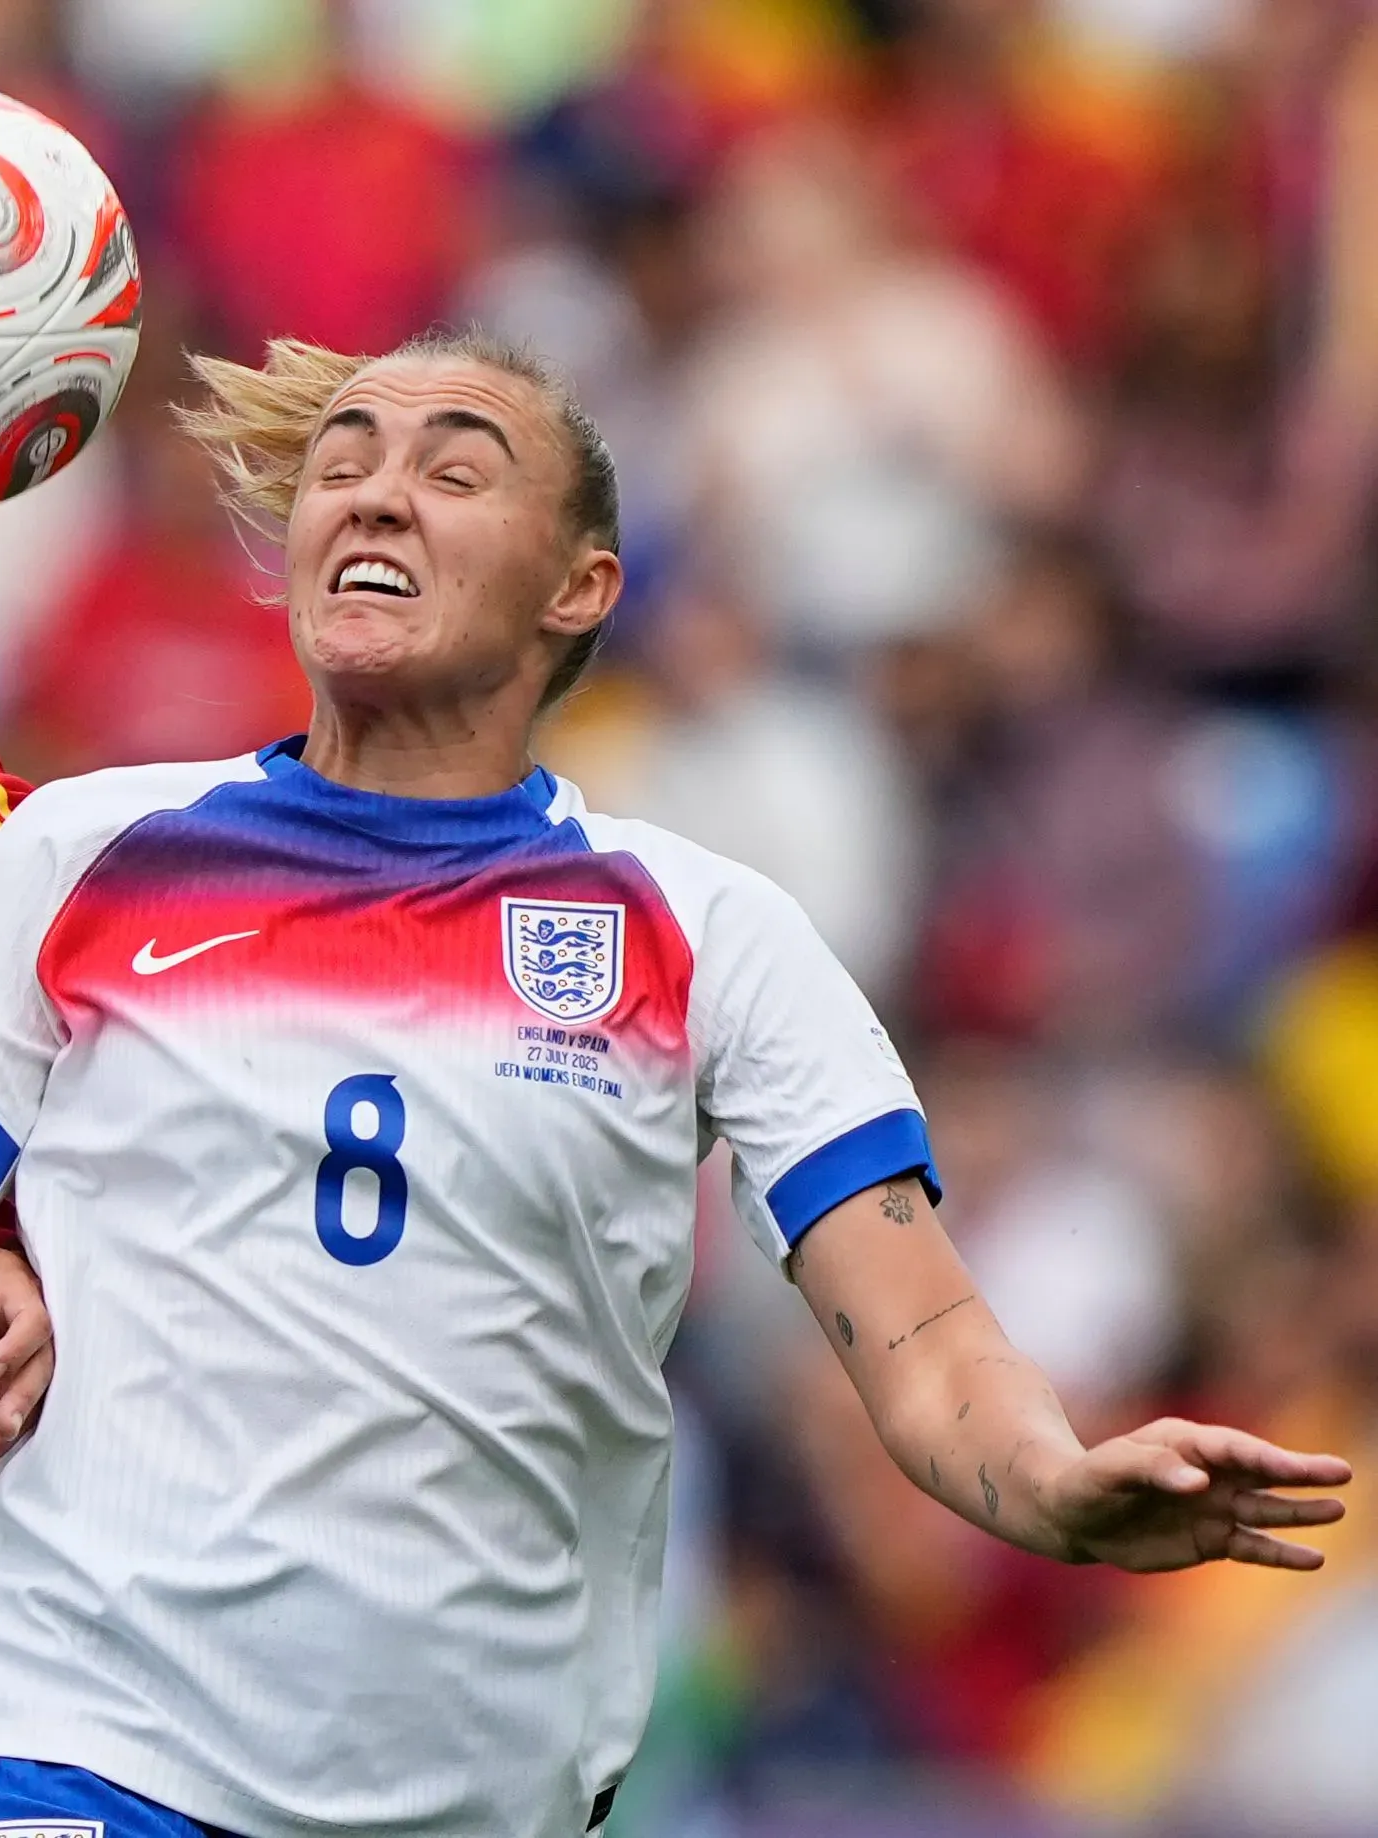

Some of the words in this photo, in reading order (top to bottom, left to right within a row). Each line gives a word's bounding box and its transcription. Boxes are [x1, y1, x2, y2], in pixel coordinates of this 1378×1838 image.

[518, 1026, 566, 1046] ENGLAND
[577, 1034, 610, 1054] SPAIN
[527, 1046, 542, 1061] 27
[545, 1047, 568, 1065] JULY
[571, 1053, 598, 1072] 2025
[494, 1062, 521, 1078] UEFA
[522, 1065, 570, 1085] WOMENS
[572, 1072, 596, 1092] EURO
[598, 1078, 623, 1100] FINAL
[315, 1073, 408, 1267] 8
